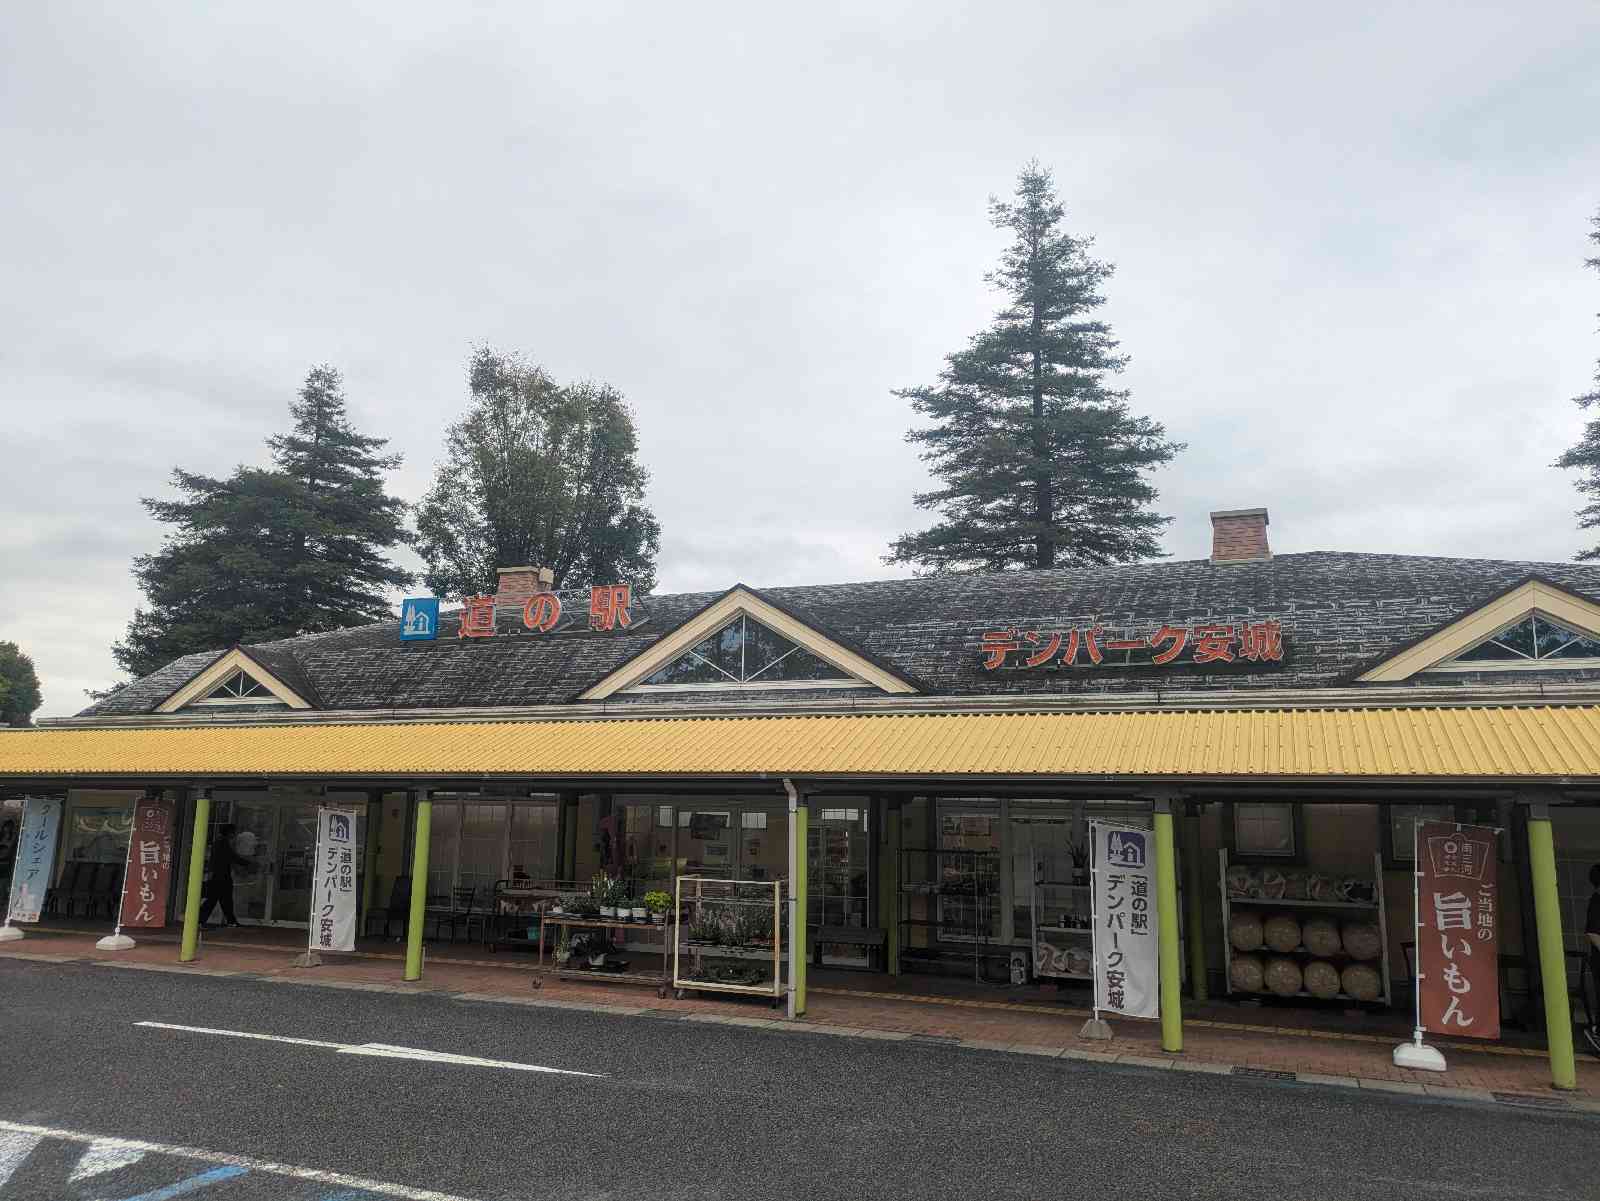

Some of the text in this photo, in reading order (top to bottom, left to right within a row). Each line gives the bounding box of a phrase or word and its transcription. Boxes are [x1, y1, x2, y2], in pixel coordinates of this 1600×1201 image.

[458, 584, 632, 639] 道の駅
[980, 619, 1284, 670] デンパーク安城
[135, 840, 161, 922] 旨いもん
[1106, 873, 1127, 1010] デンパーク安城
[1432, 889, 1474, 1029] 旨いもん
